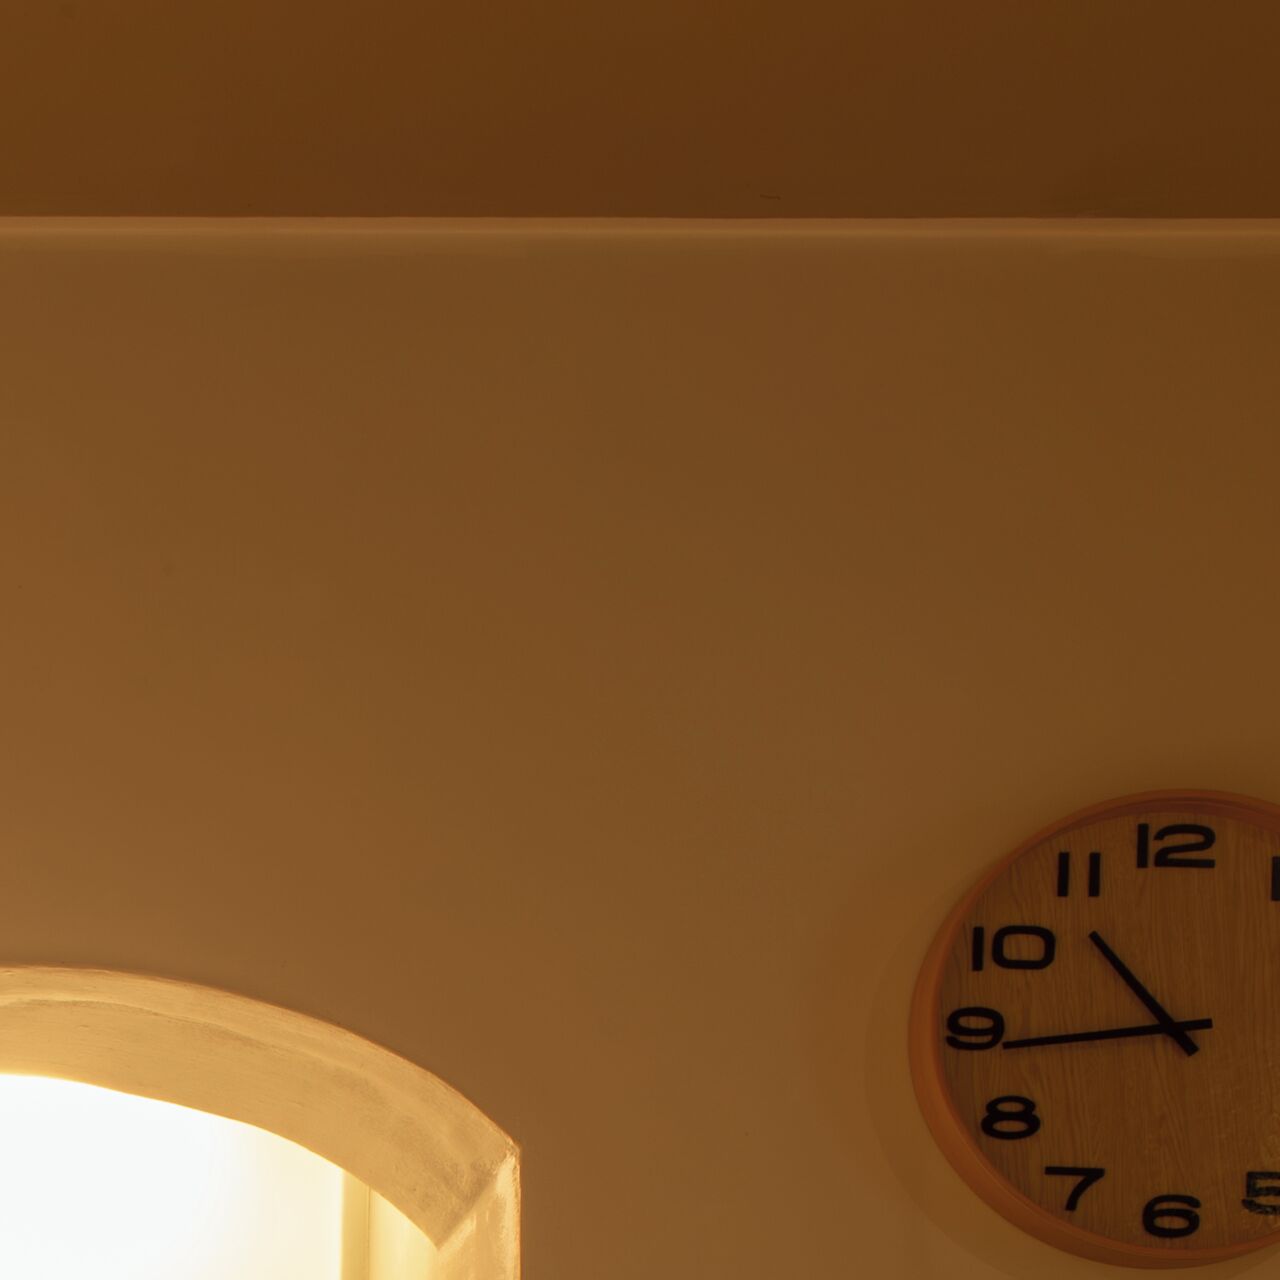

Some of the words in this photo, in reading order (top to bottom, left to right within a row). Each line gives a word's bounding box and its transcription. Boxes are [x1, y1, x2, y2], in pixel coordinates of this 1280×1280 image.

[1136, 823, 1216, 869] 12
[1057, 851, 1101, 897] 11
[972, 925, 1056, 972] 10
[946, 1007, 1005, 1051] 9
[980, 1095, 1041, 1140] 8
[1044, 1166, 1105, 1212] 7
[1241, 1171, 1280, 1215] 5
[1142, 1194, 1201, 1239] 6
